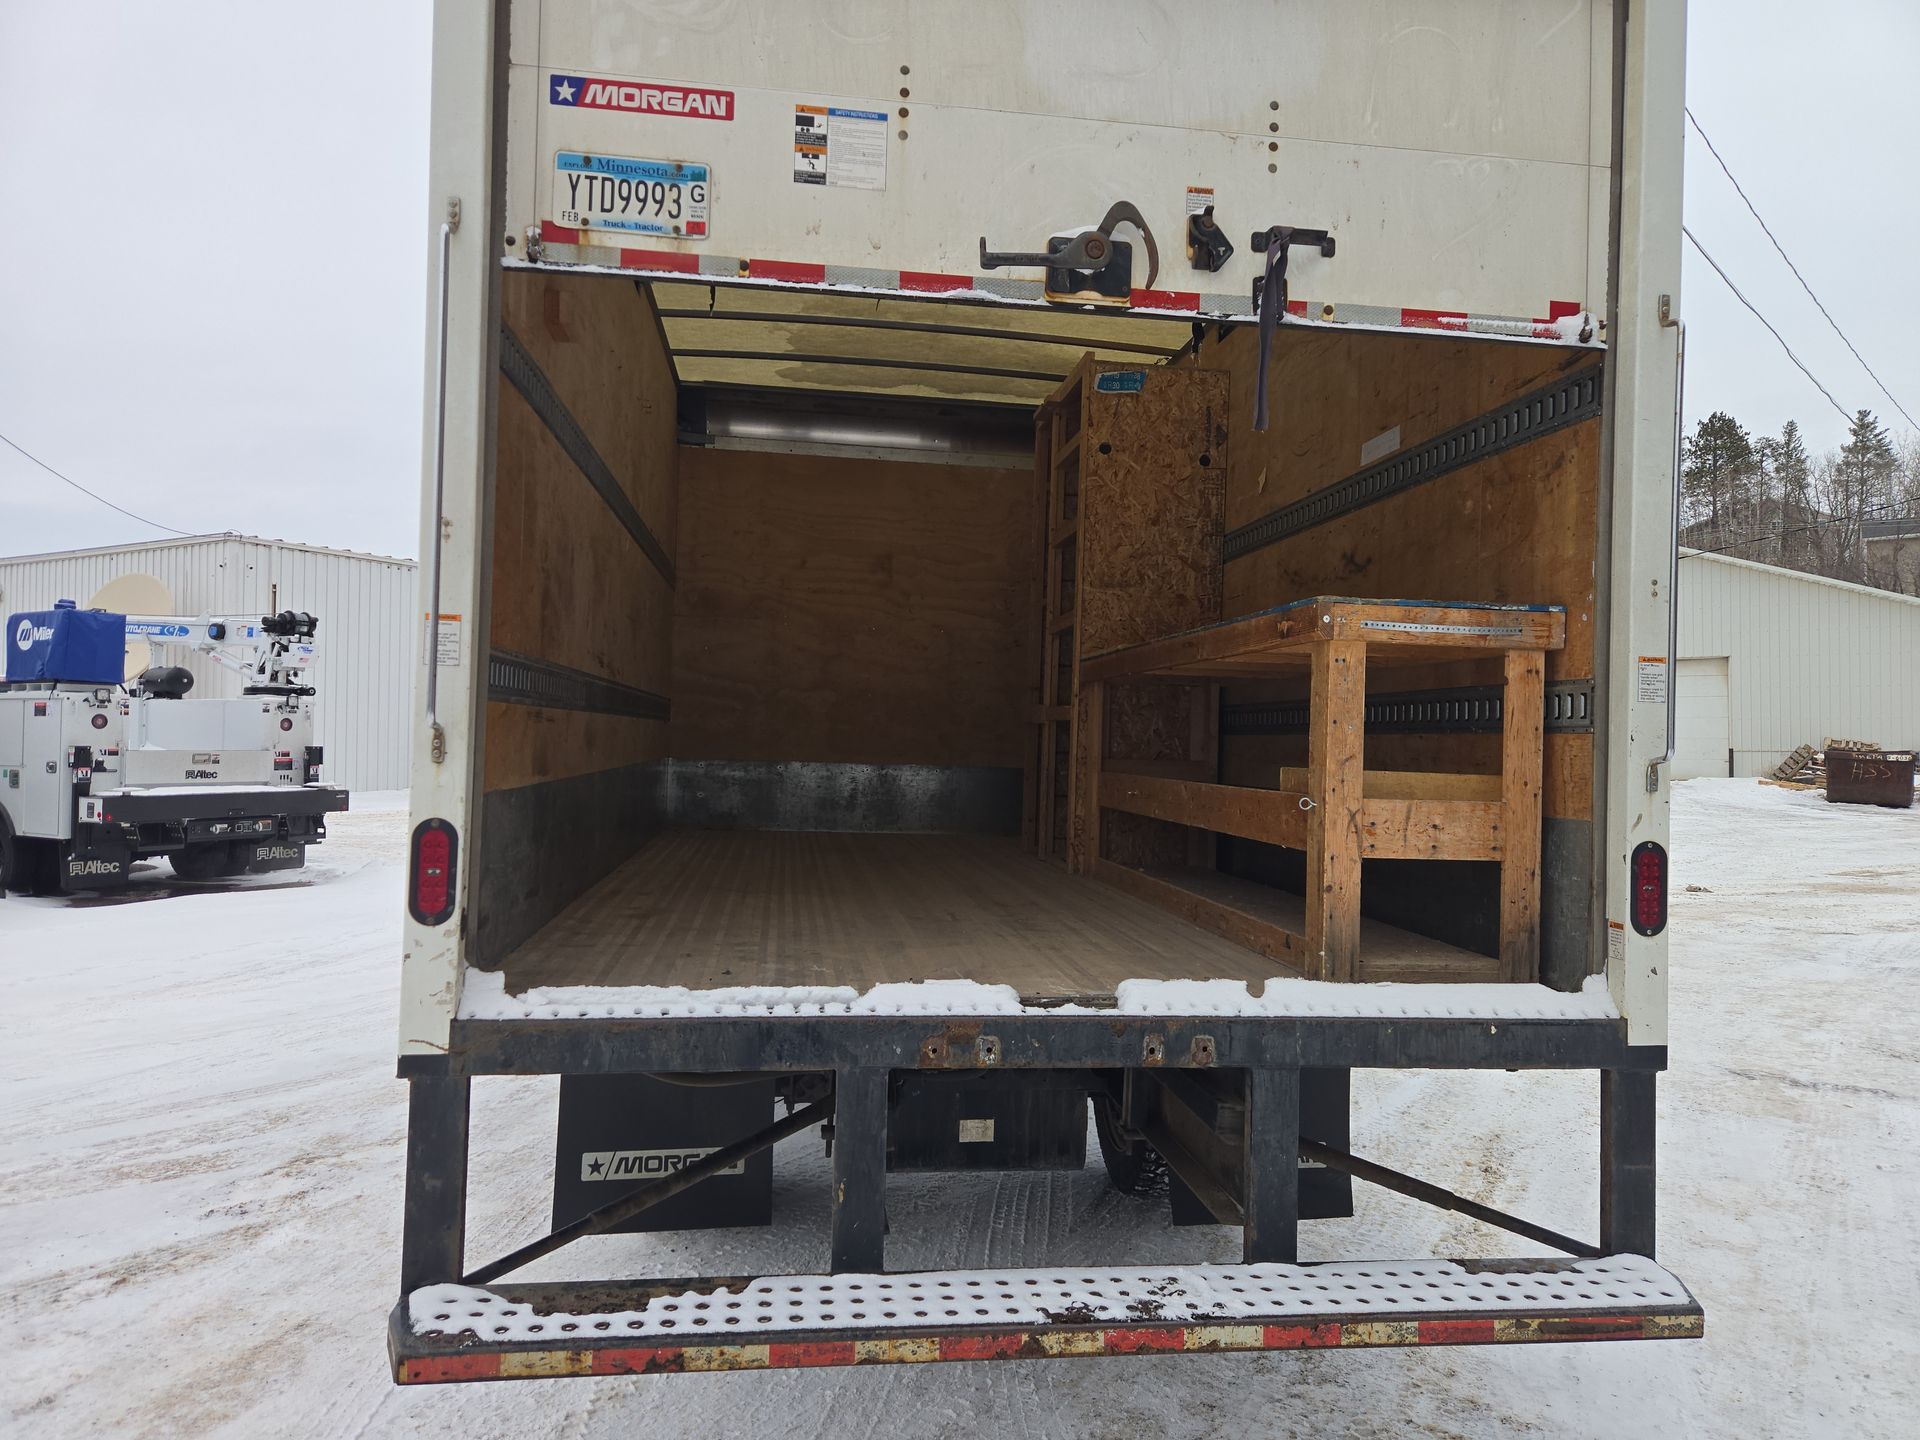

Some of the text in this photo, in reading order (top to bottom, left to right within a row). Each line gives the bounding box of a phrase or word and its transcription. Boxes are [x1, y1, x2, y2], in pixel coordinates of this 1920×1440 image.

[584, 83, 727, 116] MORGAN
[567, 173, 682, 219] YTD9993
[690, 184, 705, 203] G
[562, 210, 579, 222] FEB
[602, 219, 626, 229] Truck
[634, 221, 664, 232] Tractor
[195, 769, 218, 779] Altec
[269, 846, 298, 859] Altec
[84, 860, 120, 874] Altec
